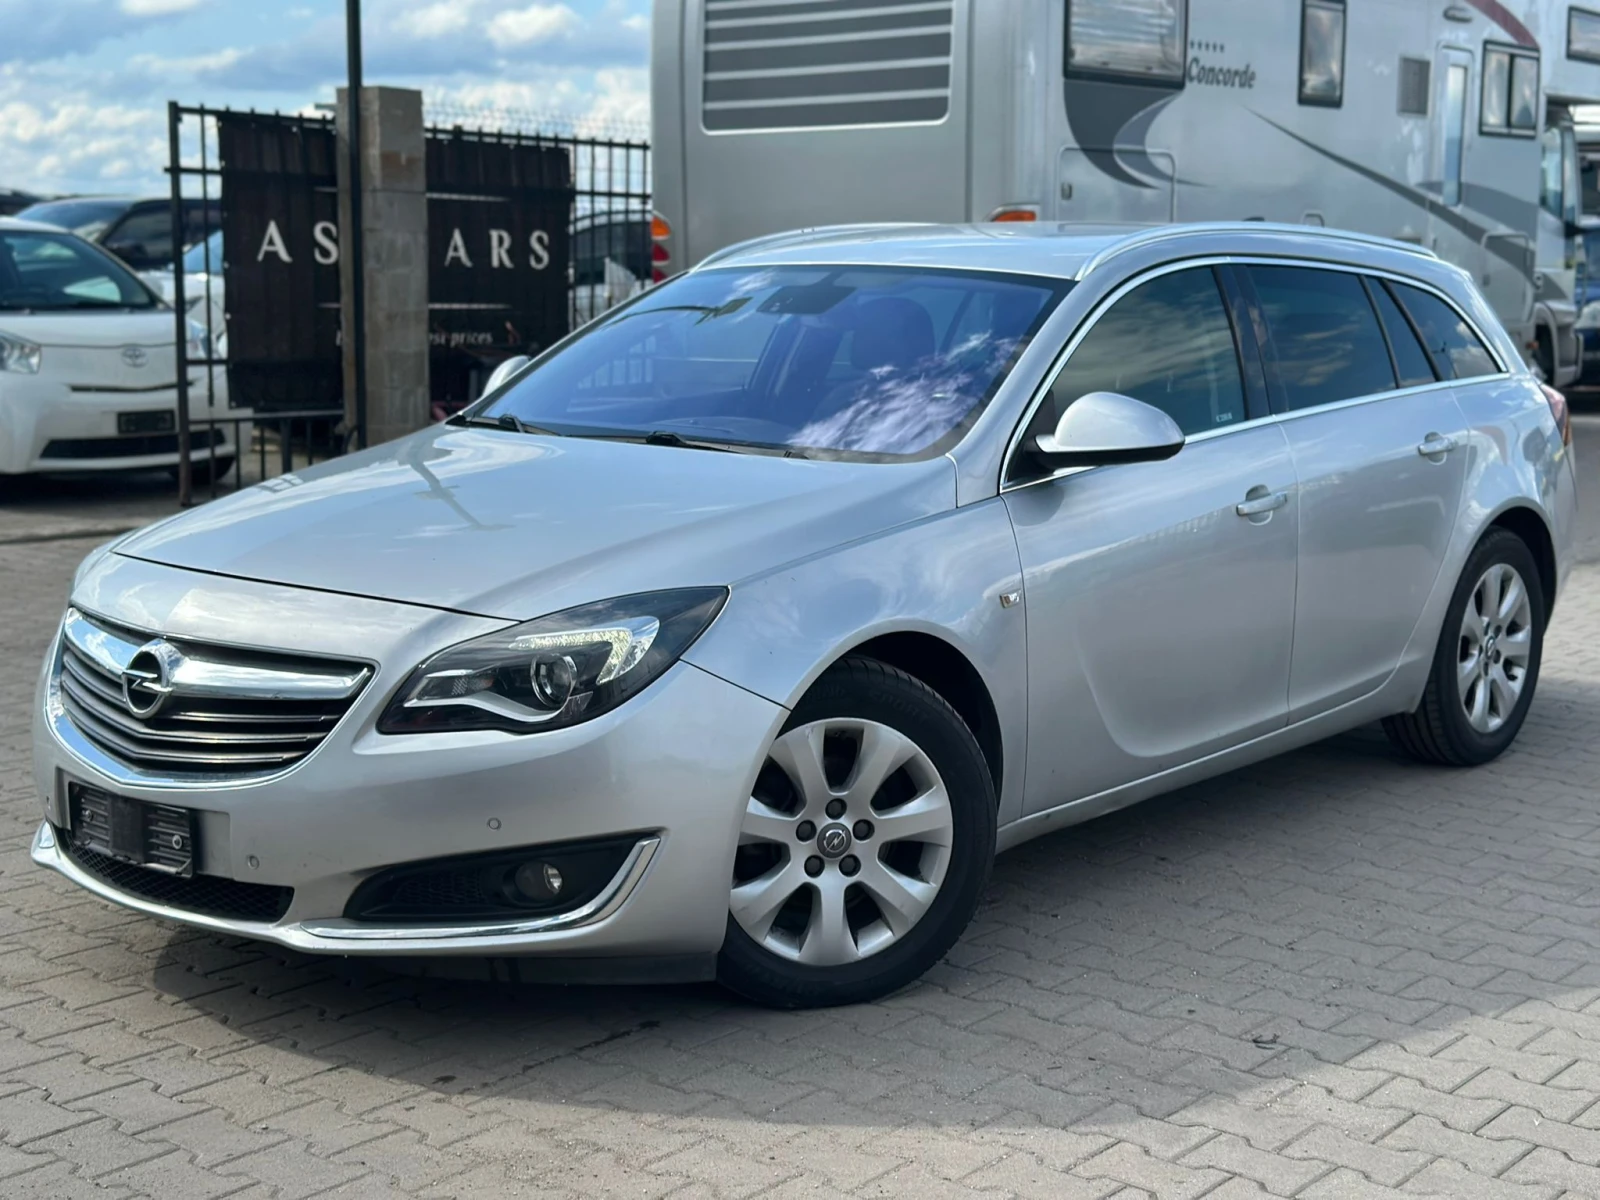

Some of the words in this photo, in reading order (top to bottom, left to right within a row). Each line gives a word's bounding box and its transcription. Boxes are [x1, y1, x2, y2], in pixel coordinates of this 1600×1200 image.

[1187, 57, 1256, 89] Concorde
[444, 227, 550, 270] ARS
[450, 330, 493, 347] prices
